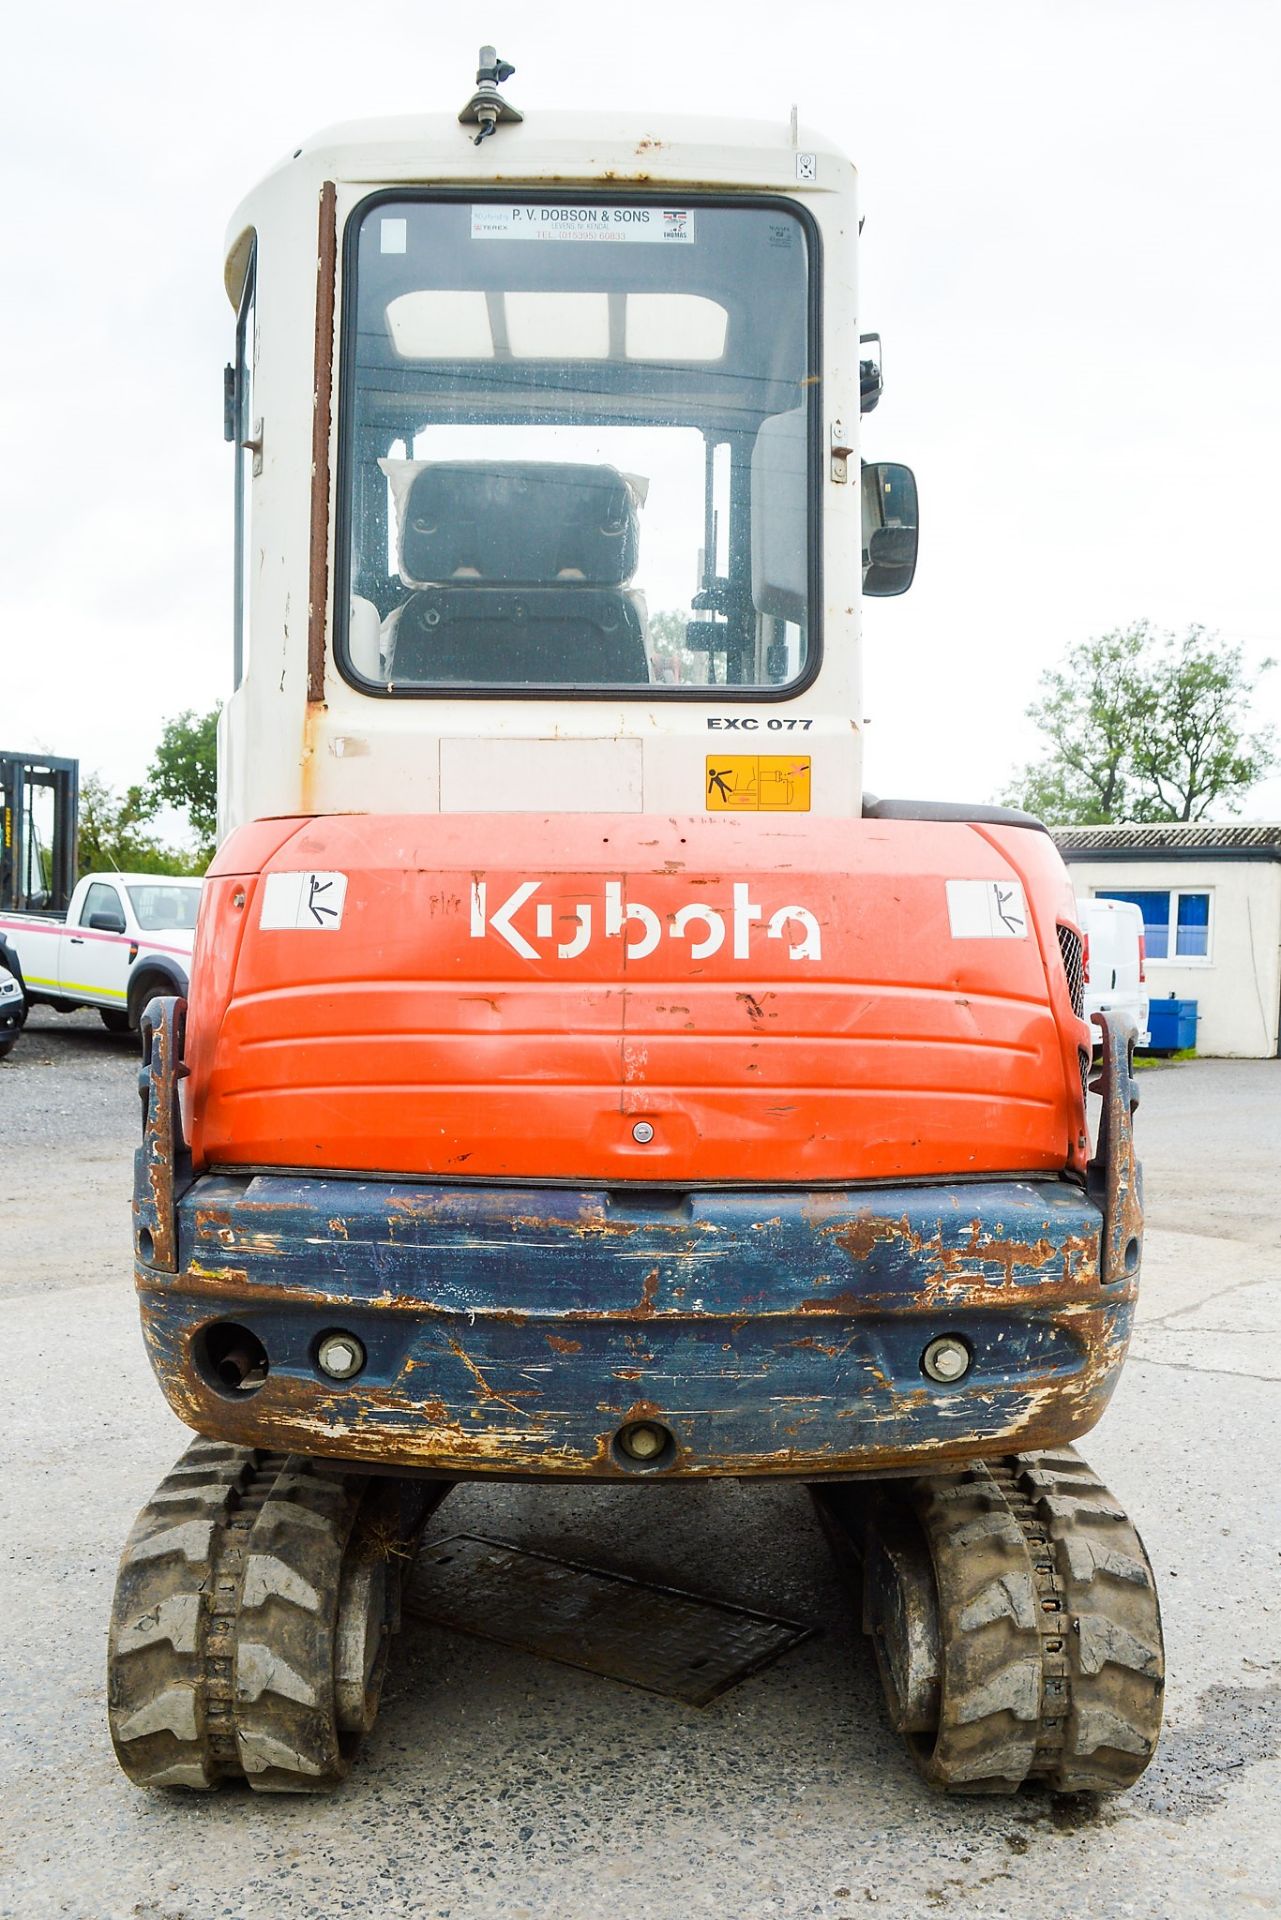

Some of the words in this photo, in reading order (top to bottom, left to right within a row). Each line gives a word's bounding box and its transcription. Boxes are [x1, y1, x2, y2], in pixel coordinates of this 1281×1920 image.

[511, 208, 523, 221] P.
[526, 209, 537, 221] V.
[541, 209, 597, 222] DOBSON
[601, 210, 610, 222] &
[614, 210, 650, 223] SONS
[663, 231, 687, 239] THOMAS
[707, 718, 760, 730] EXC
[767, 719, 813, 731] 077
[470, 881, 822, 961] Kubota
